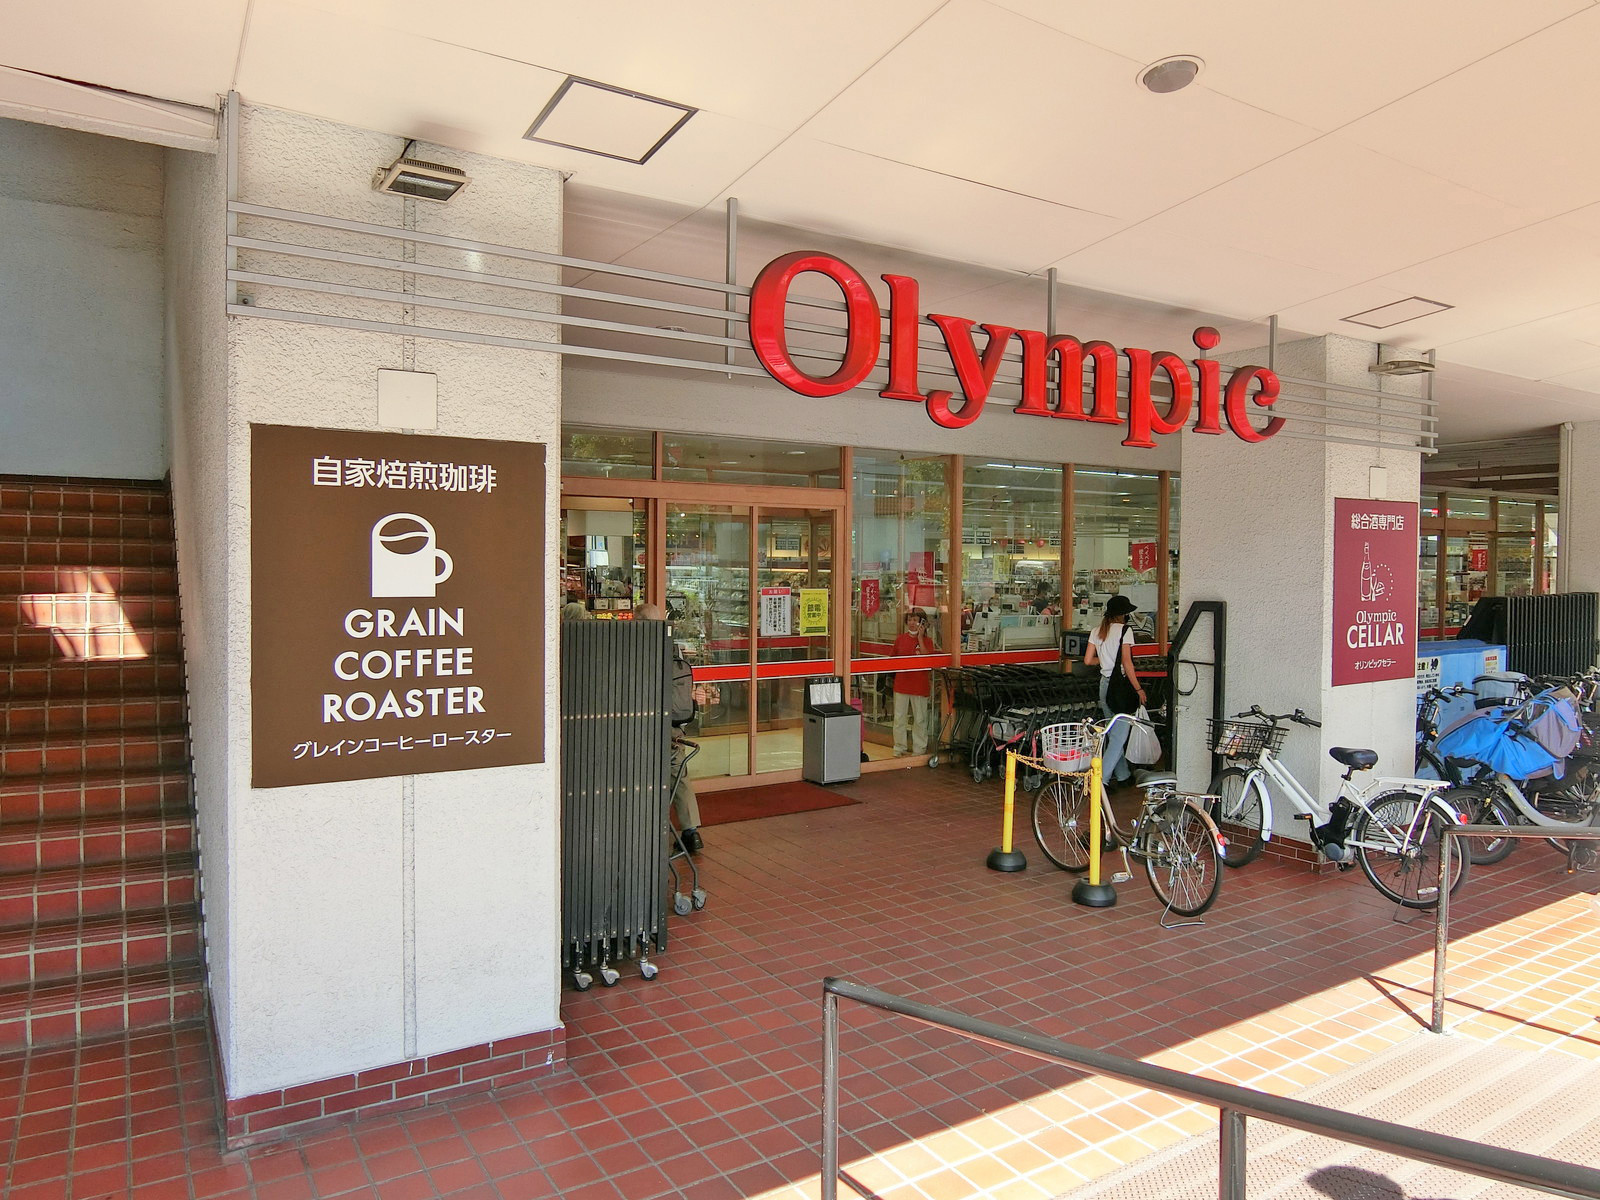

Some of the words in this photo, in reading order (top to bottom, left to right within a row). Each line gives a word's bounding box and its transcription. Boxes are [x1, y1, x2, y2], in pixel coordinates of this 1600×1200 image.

[748, 250, 1287, 449] Olympic
[312, 455, 498, 494] 自家焙煎珈琲
[1351, 513, 1405, 531] 総合酒専門店
[344, 607, 464, 639] GRAIN
[1356, 609, 1397, 625] Olympic
[1069, 639, 1077, 652] P
[1346, 622, 1405, 649] CELLAR
[334, 648, 473, 681] COFFEE
[1354, 658, 1397, 671] オリンピックセラー
[323, 686, 486, 724] ROASTER
[293, 728, 512, 760] グレインコーヒーロースター
